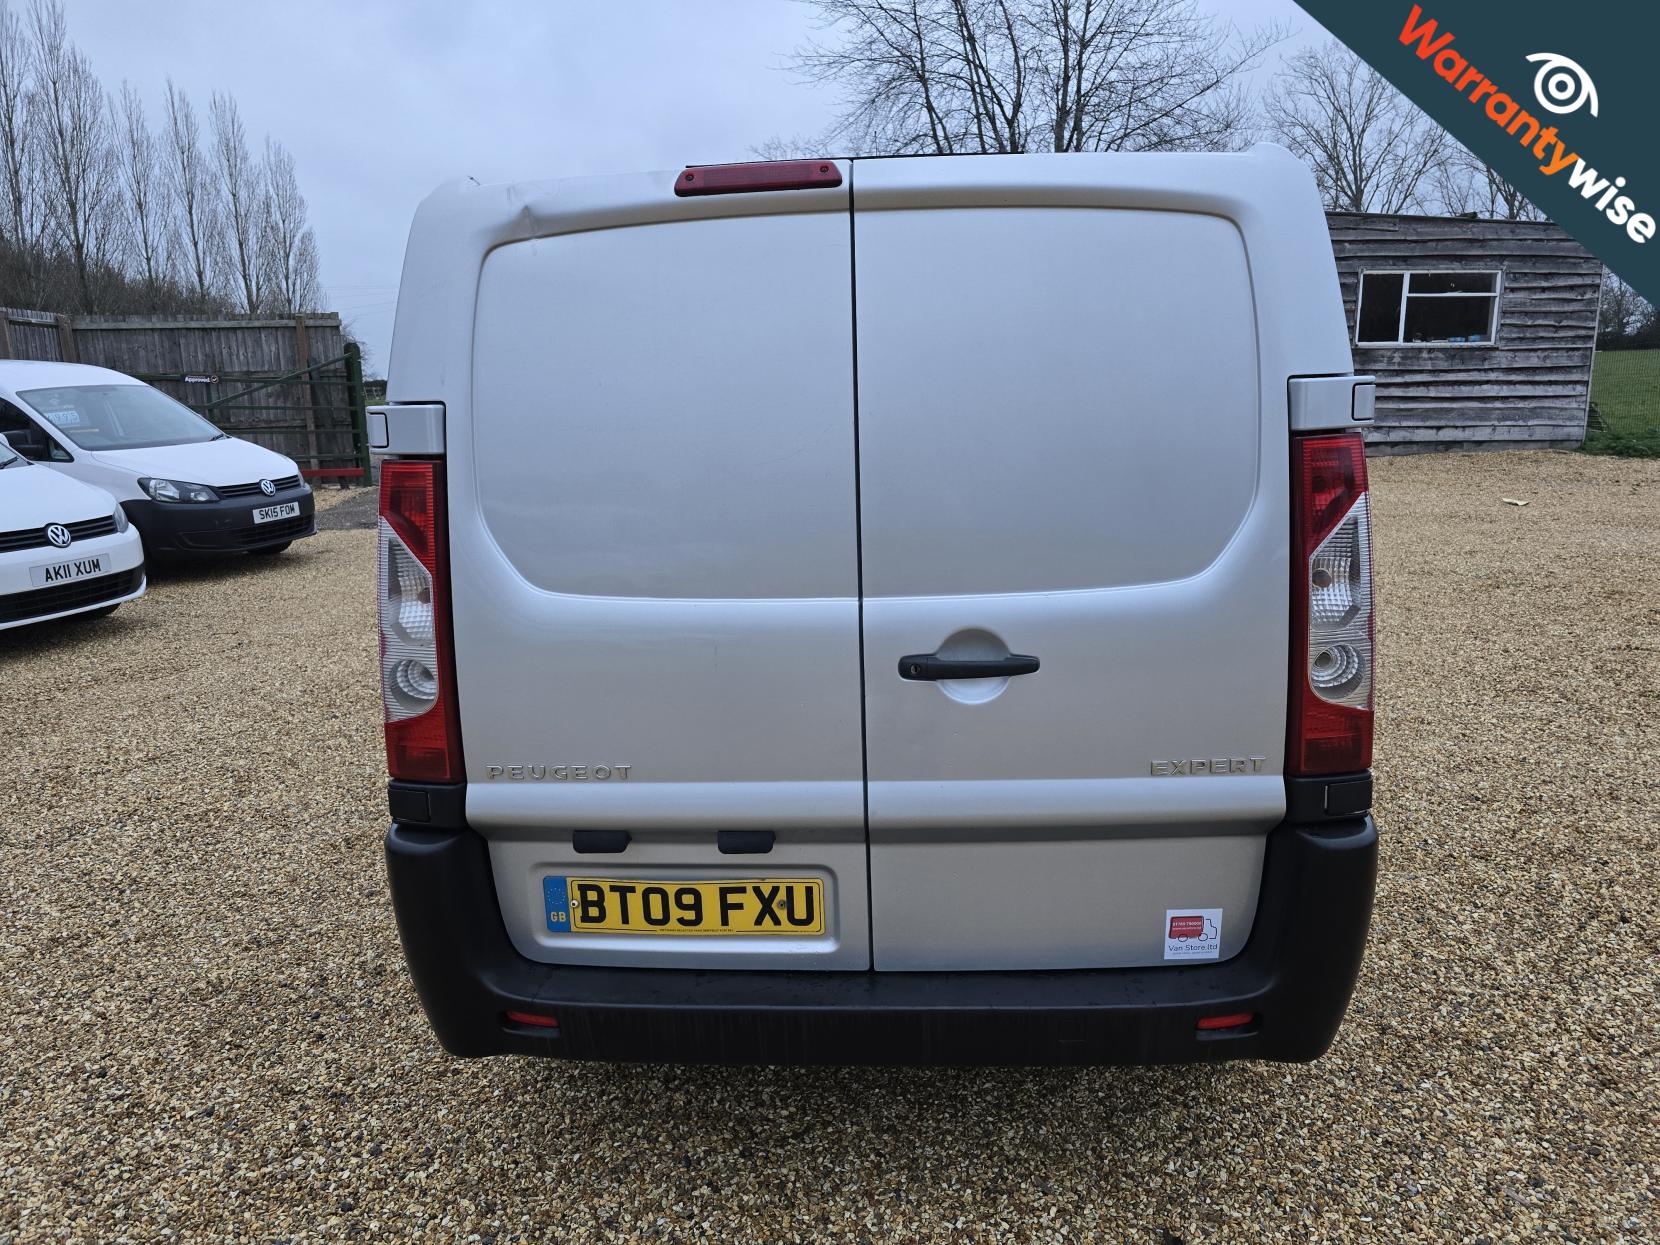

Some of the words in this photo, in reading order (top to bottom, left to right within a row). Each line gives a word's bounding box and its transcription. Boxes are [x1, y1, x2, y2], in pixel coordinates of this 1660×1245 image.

[259, 506, 279, 520] SK15
[279, 503, 296, 516] FOM
[45, 567, 72, 582] AK11
[74, 559, 102, 577] XUM
[485, 764, 632, 780] PEUGEOT
[1150, 755, 1267, 776] EXPERT
[577, 883, 704, 927] BT09
[718, 885, 816, 927] FXU
[550, 911, 567, 922] GB
